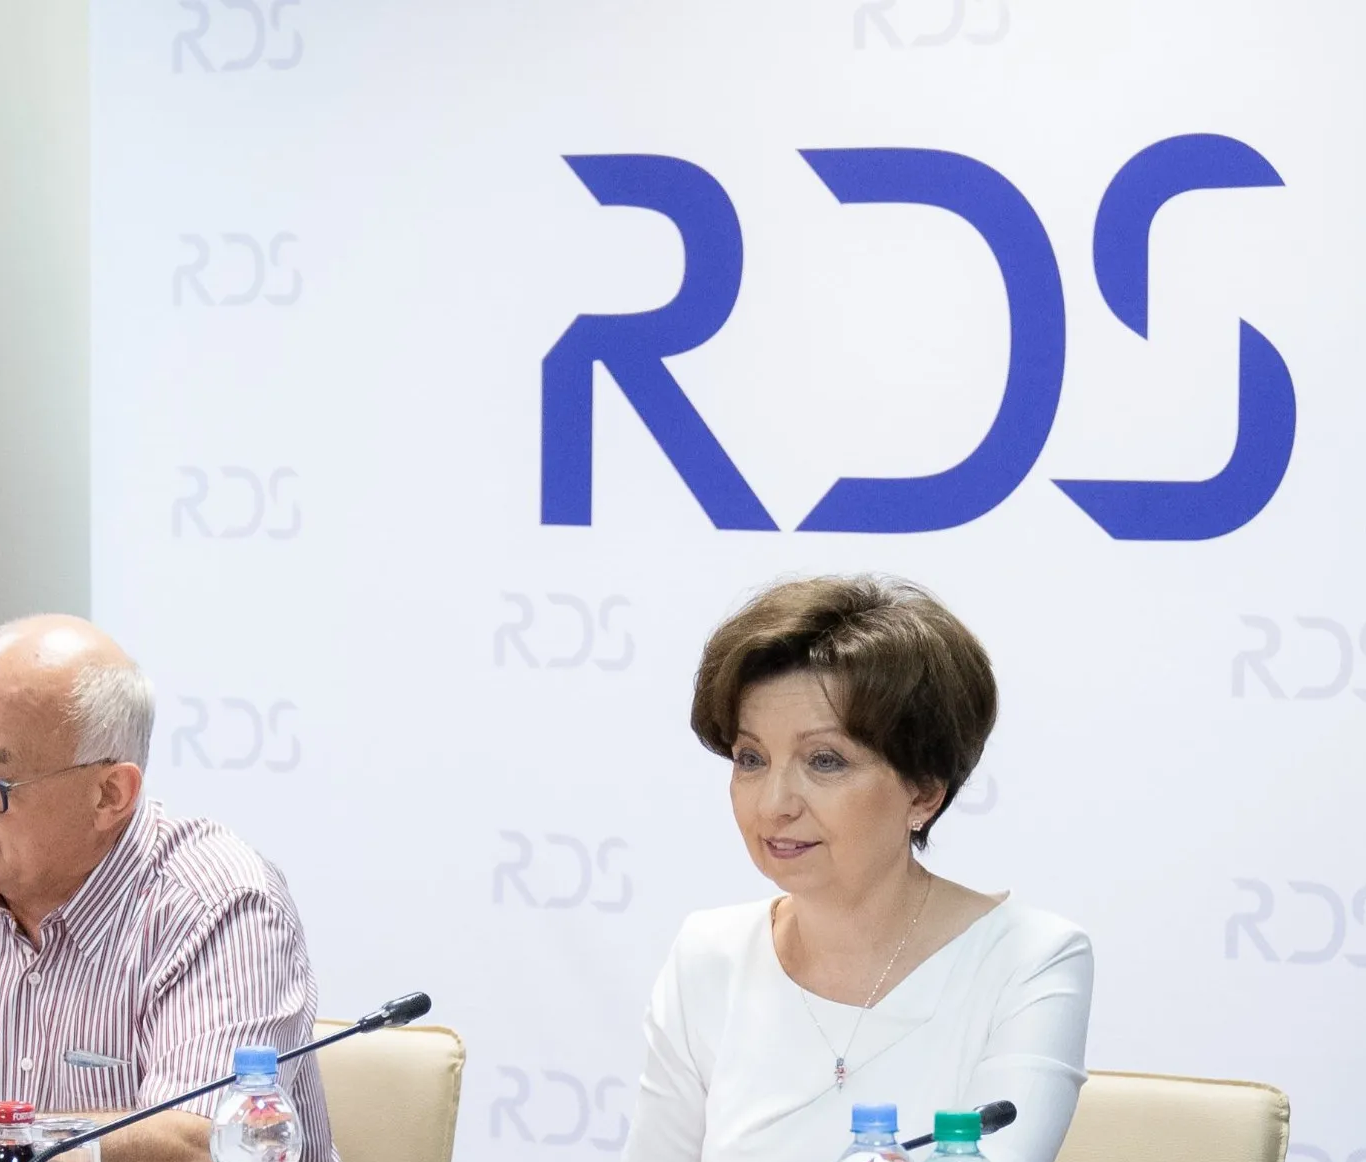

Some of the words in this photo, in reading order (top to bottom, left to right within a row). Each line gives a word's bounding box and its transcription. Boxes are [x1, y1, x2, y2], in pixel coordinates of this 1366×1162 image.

[171, 232, 303, 307] RDS
[541, 133, 1296, 541] RDS
[171, 466, 303, 541] RDS
[494, 592, 636, 671] RDS
[172, 696, 302, 774] RDS
[492, 829, 635, 912] RDS
[490, 1064, 630, 1152] RDS
